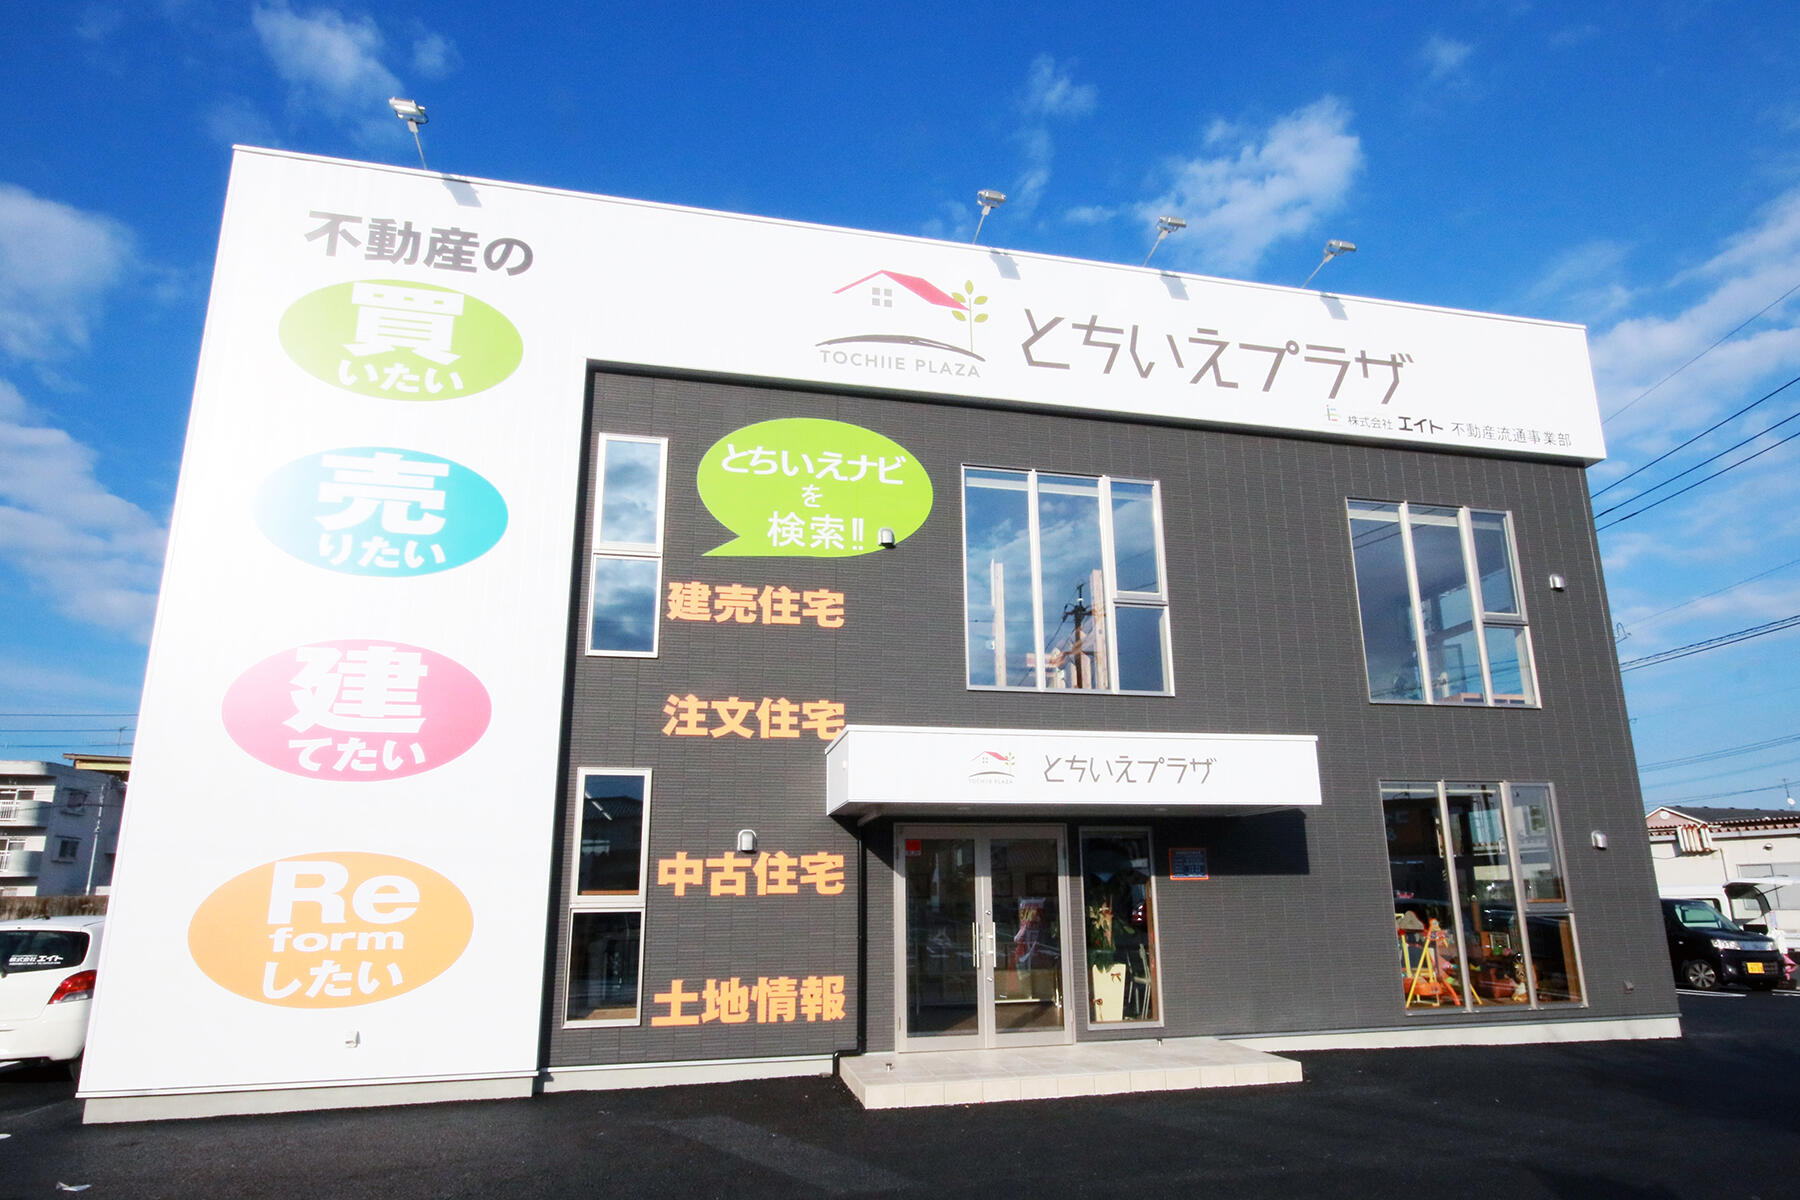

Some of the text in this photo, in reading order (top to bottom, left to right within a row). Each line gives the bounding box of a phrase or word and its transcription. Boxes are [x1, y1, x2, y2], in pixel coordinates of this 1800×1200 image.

[304, 210, 534, 276] 不動産の
[341, 282, 465, 365] 買
[338, 359, 464, 393] いたい
[819, 350, 981, 378] TOCHIIE PLAZA
[1021, 308, 1414, 405] とちいえプラザ
[1347, 415, 1573, 448] 株式会社 エイト 不動産流通事業部
[721, 443, 907, 485] とちいえナビ
[313, 452, 450, 536] 売
[801, 484, 823, 508] を
[318, 535, 446, 569] りたい
[666, 581, 845, 628] 建売住宅
[282, 646, 428, 734] 建
[662, 693, 846, 741] 注文住宅
[288, 736, 426, 772] てたい
[1044, 755, 1217, 784] とちいえプラザ
[267, 860, 420, 925] Re
[657, 851, 846, 897] 中古住宅
[268, 927, 405, 953] form
[262, 959, 404, 1000] したい
[650, 975, 846, 1027] 土地情報
